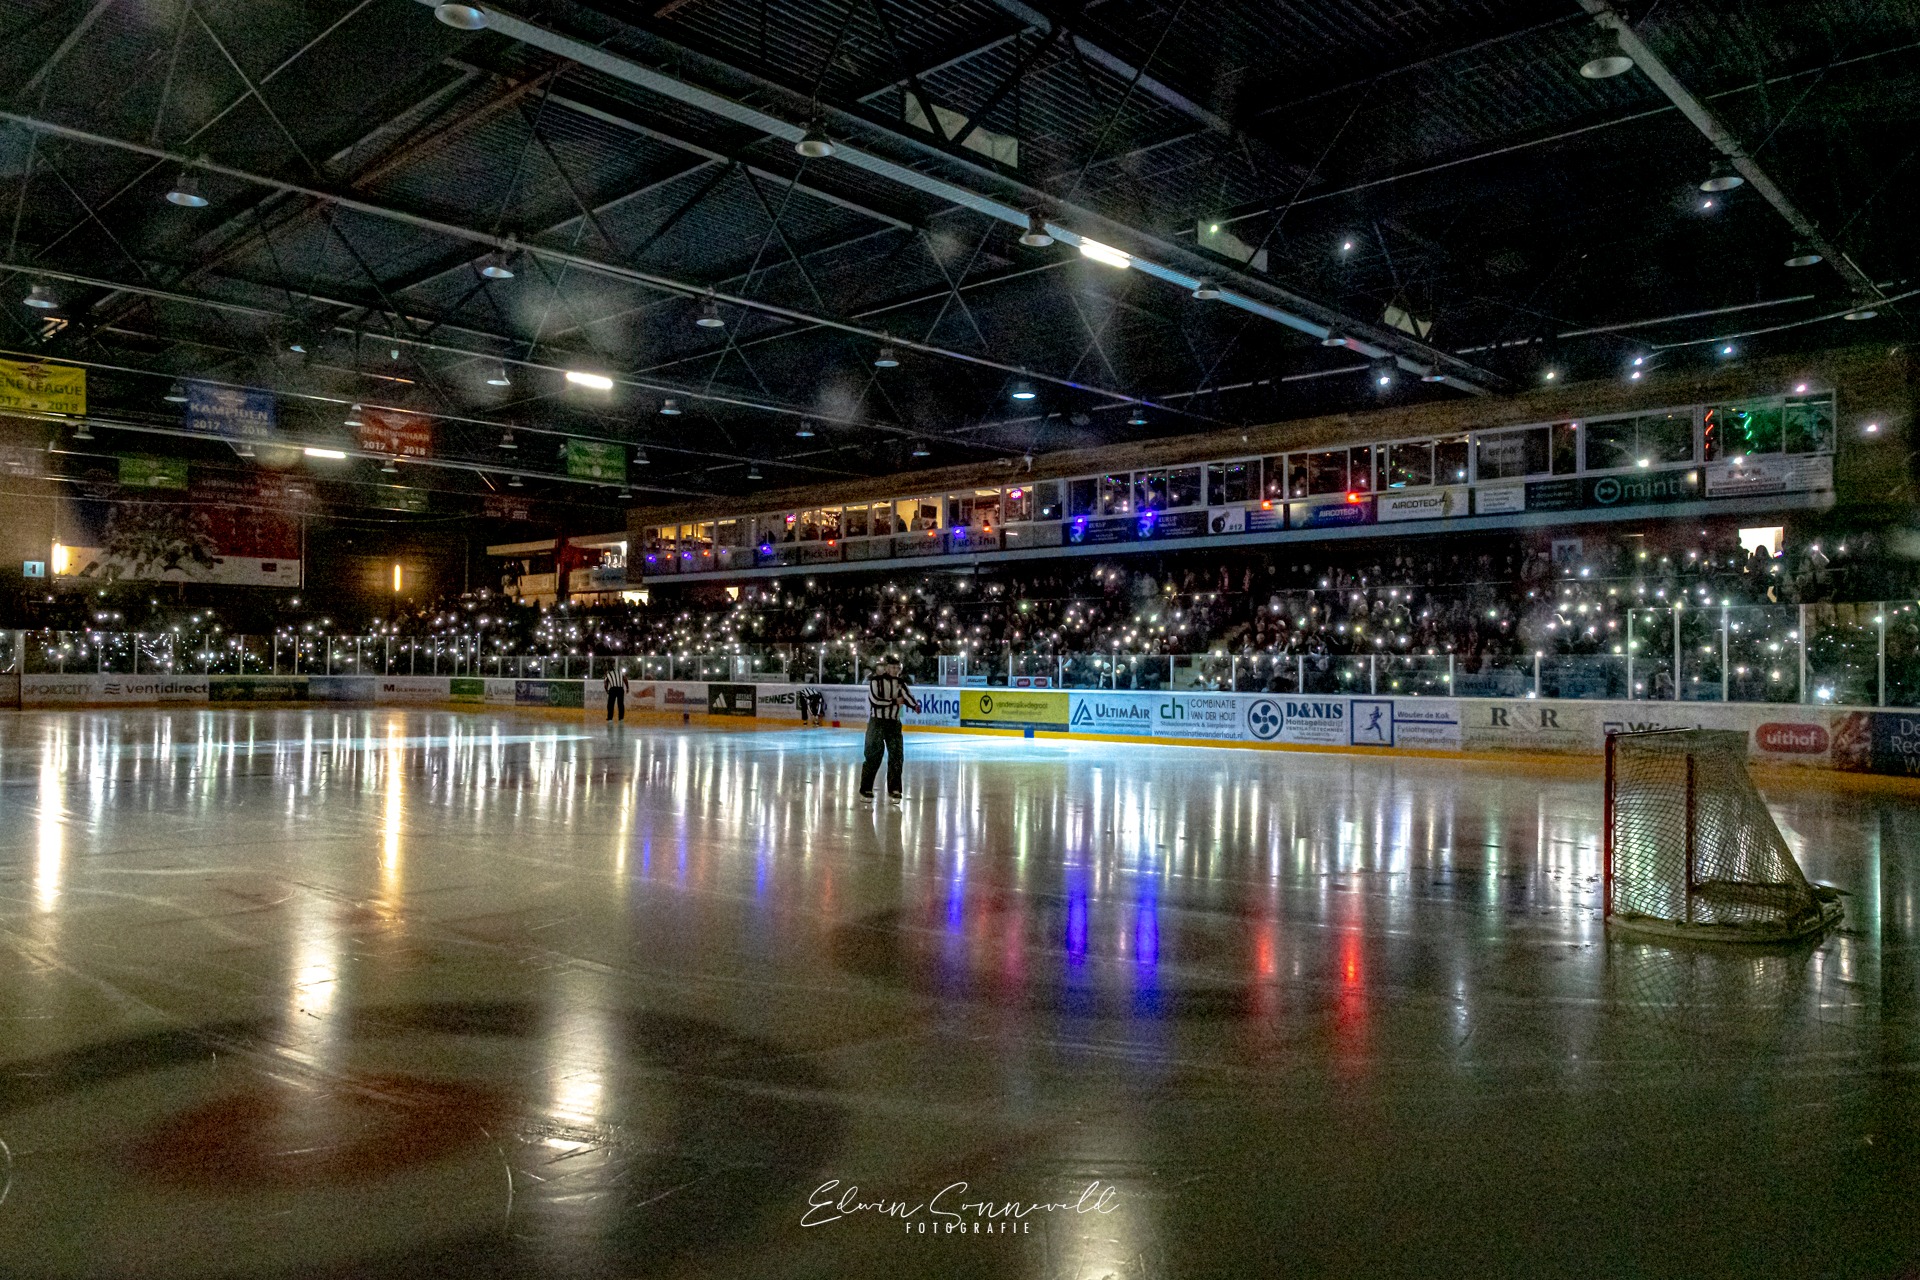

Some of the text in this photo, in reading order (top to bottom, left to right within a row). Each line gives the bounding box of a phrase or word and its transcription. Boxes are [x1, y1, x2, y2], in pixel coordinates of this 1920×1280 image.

[27, 381, 82, 396] LEAGUE
[48, 401, 78, 412] 2018
[193, 420, 268, 436] 2017 2018
[363, 441, 426, 455] 2017 2018
[1392, 499, 1442, 509] AIRCOTECH
[1319, 508, 1358, 518] AIRCOTECH
[127, 682, 208, 694] ventidirect
[758, 692, 795, 705] ZWENNES
[1190, 699, 1236, 709] COMBINATIE
[1160, 697, 1184, 719] ch
[1190, 711, 1236, 721] VAN DER HOUT
[1435, 711, 1449, 720] Kok
[1490, 707, 1511, 727] R
[1539, 708, 1561, 728] R
[1286, 719, 1344, 727] Montagebedrijf
[1397, 726, 1444, 735] Fysiotherapie
[1767, 731, 1816, 746] uithof
